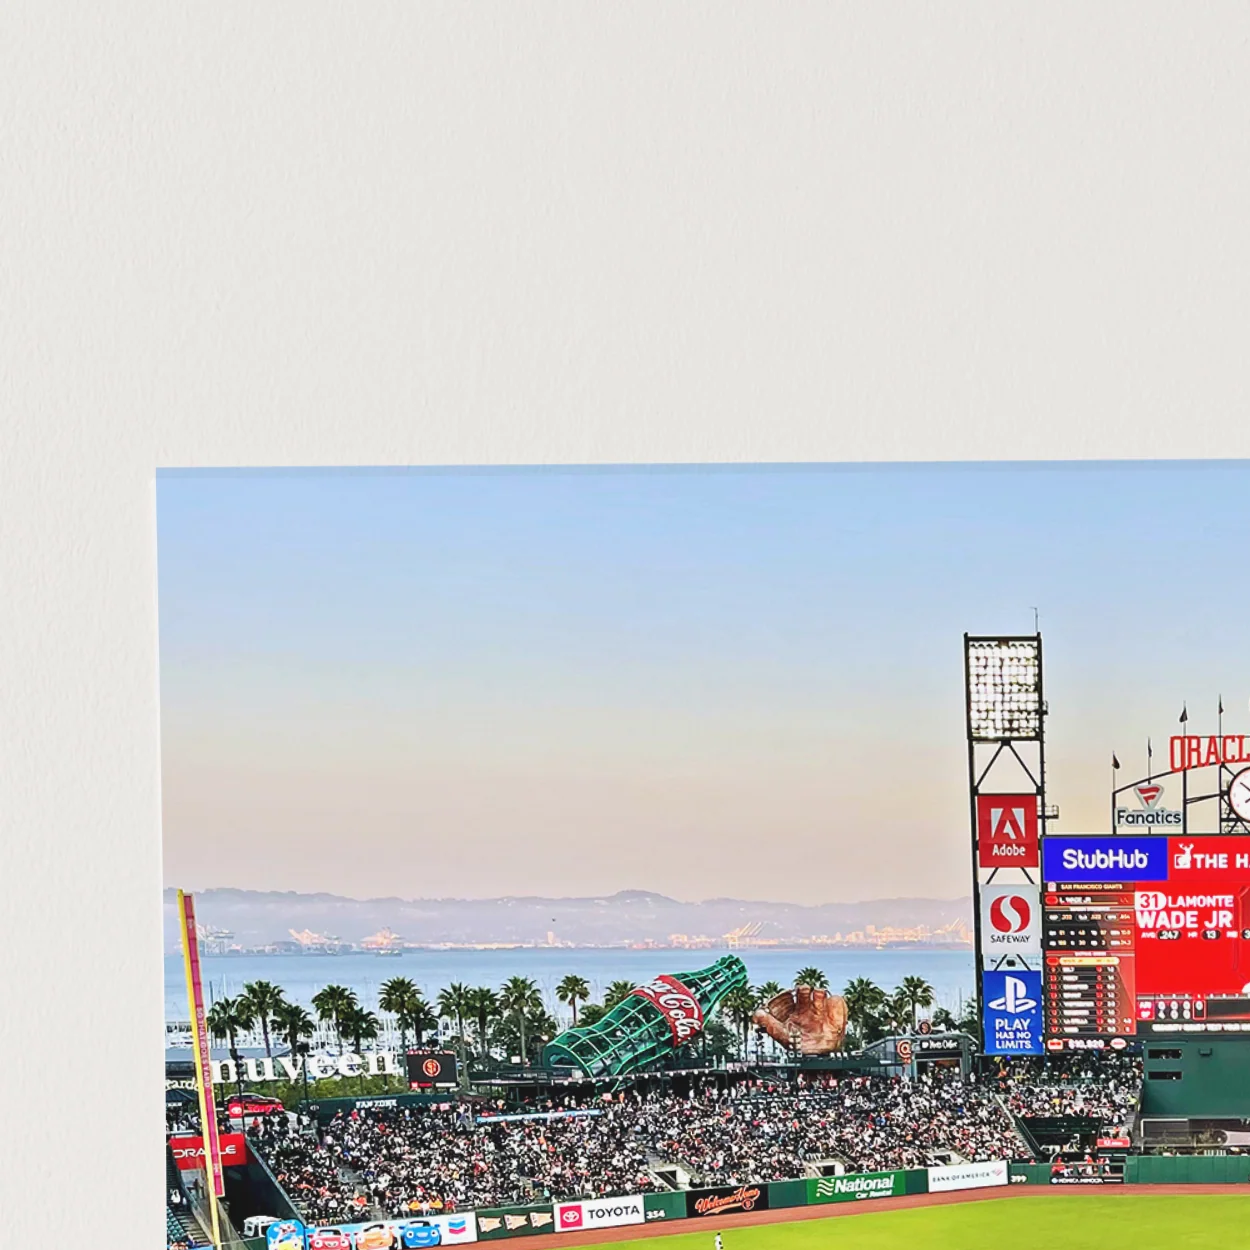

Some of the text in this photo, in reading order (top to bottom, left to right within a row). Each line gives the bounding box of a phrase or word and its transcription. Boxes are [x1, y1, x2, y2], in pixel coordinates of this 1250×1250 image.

[1117, 810, 1181, 825] Fanatics
[992, 844, 1026, 856] Adobe
[1062, 849, 1148, 869] StubHub
[1193, 853, 1228, 868] THE
[1140, 893, 1159, 908] 31
[1168, 895, 1234, 907] LAMONTE
[1135, 910, 1199, 928] WADE
[1204, 910, 1233, 928] JR
[990, 934, 1031, 944] SAFEWAY
[995, 1018, 1030, 1031] PLAY
[996, 1032, 1031, 1040] HAS NO
[211, 1050, 401, 1084] nuveen
[172, 1145, 236, 1158] ORALE
[834, 1174, 895, 1194] National
[868, 1189, 892, 1198] Rental
[587, 1205, 640, 1220] TOYOTA
